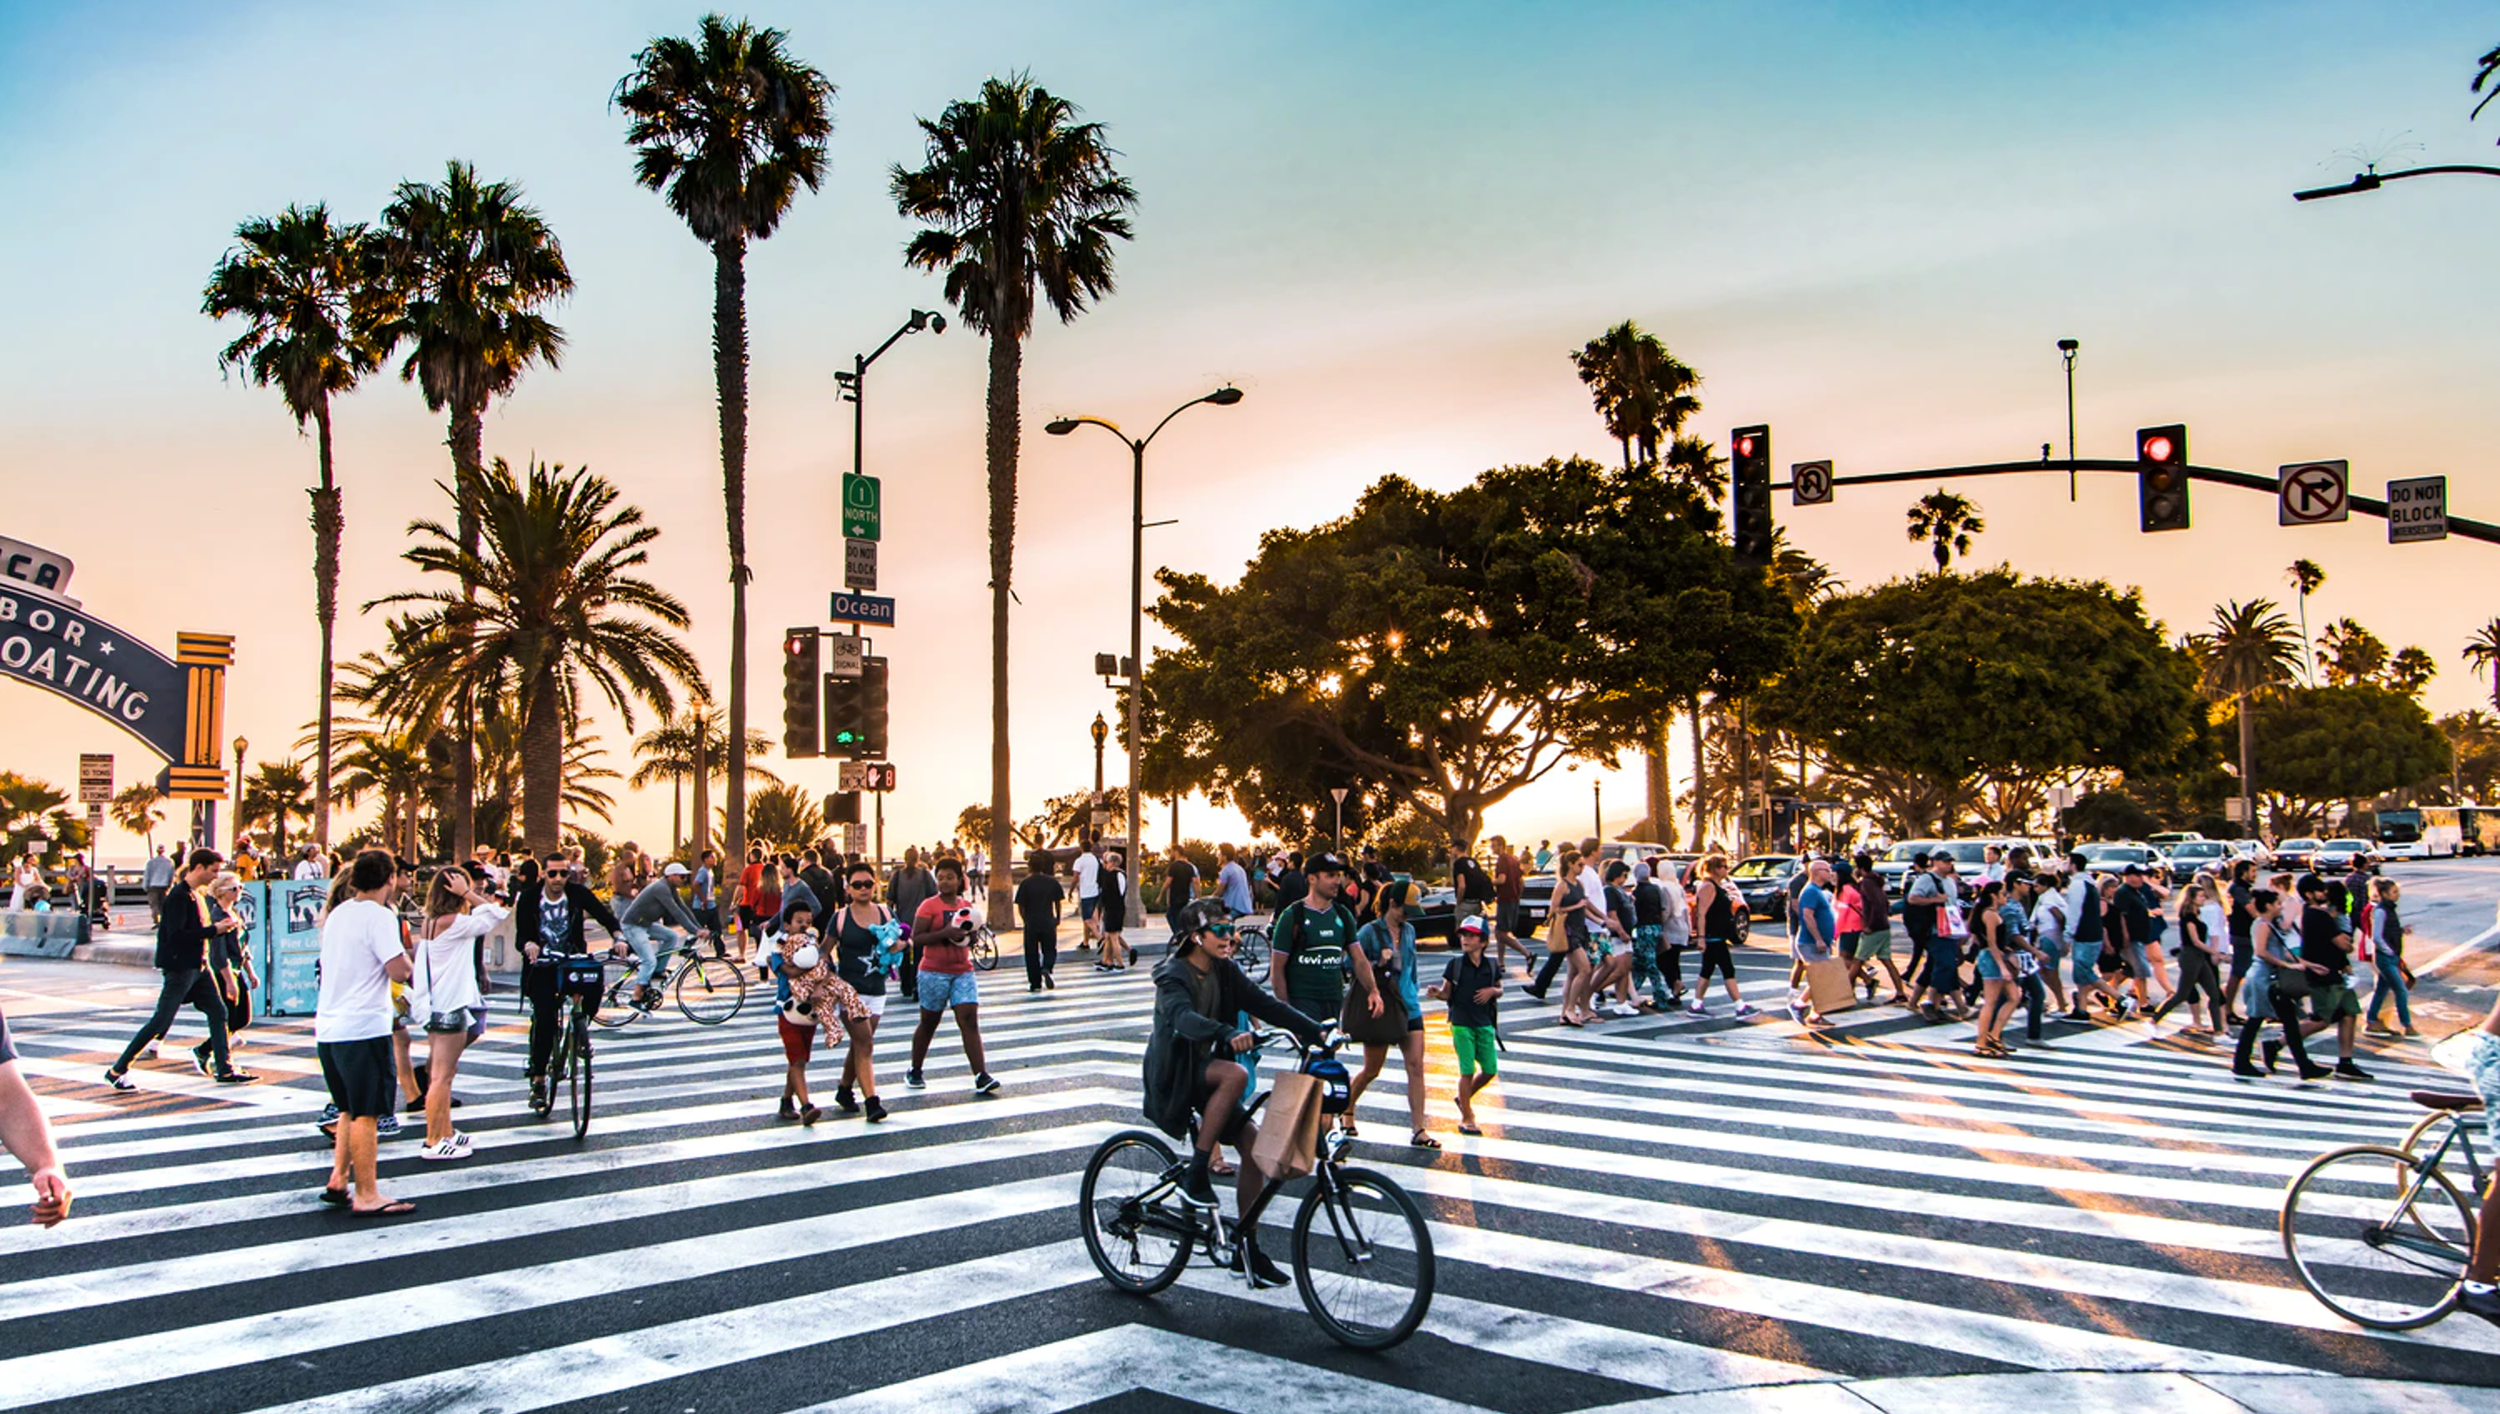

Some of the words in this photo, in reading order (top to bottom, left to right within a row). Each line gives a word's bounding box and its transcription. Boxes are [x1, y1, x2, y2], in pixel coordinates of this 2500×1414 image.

[860, 487, 864, 502] 1
[2391, 488, 2411, 503] DO
[2414, 485, 2442, 501] NOT
[844, 507, 878, 523] NORTH
[2392, 505, 2443, 523] BLOCK
[847, 546, 859, 558] DO
[860, 548, 875, 560] NOT
[0, 548, 61, 591] CA
[847, 561, 875, 575] BLOCK
[835, 596, 891, 618] Ocean
[835, 660, 860, 670] SIGNAL
[1, 636, 149, 721] OATING
[92, 769, 111, 777] TONS
